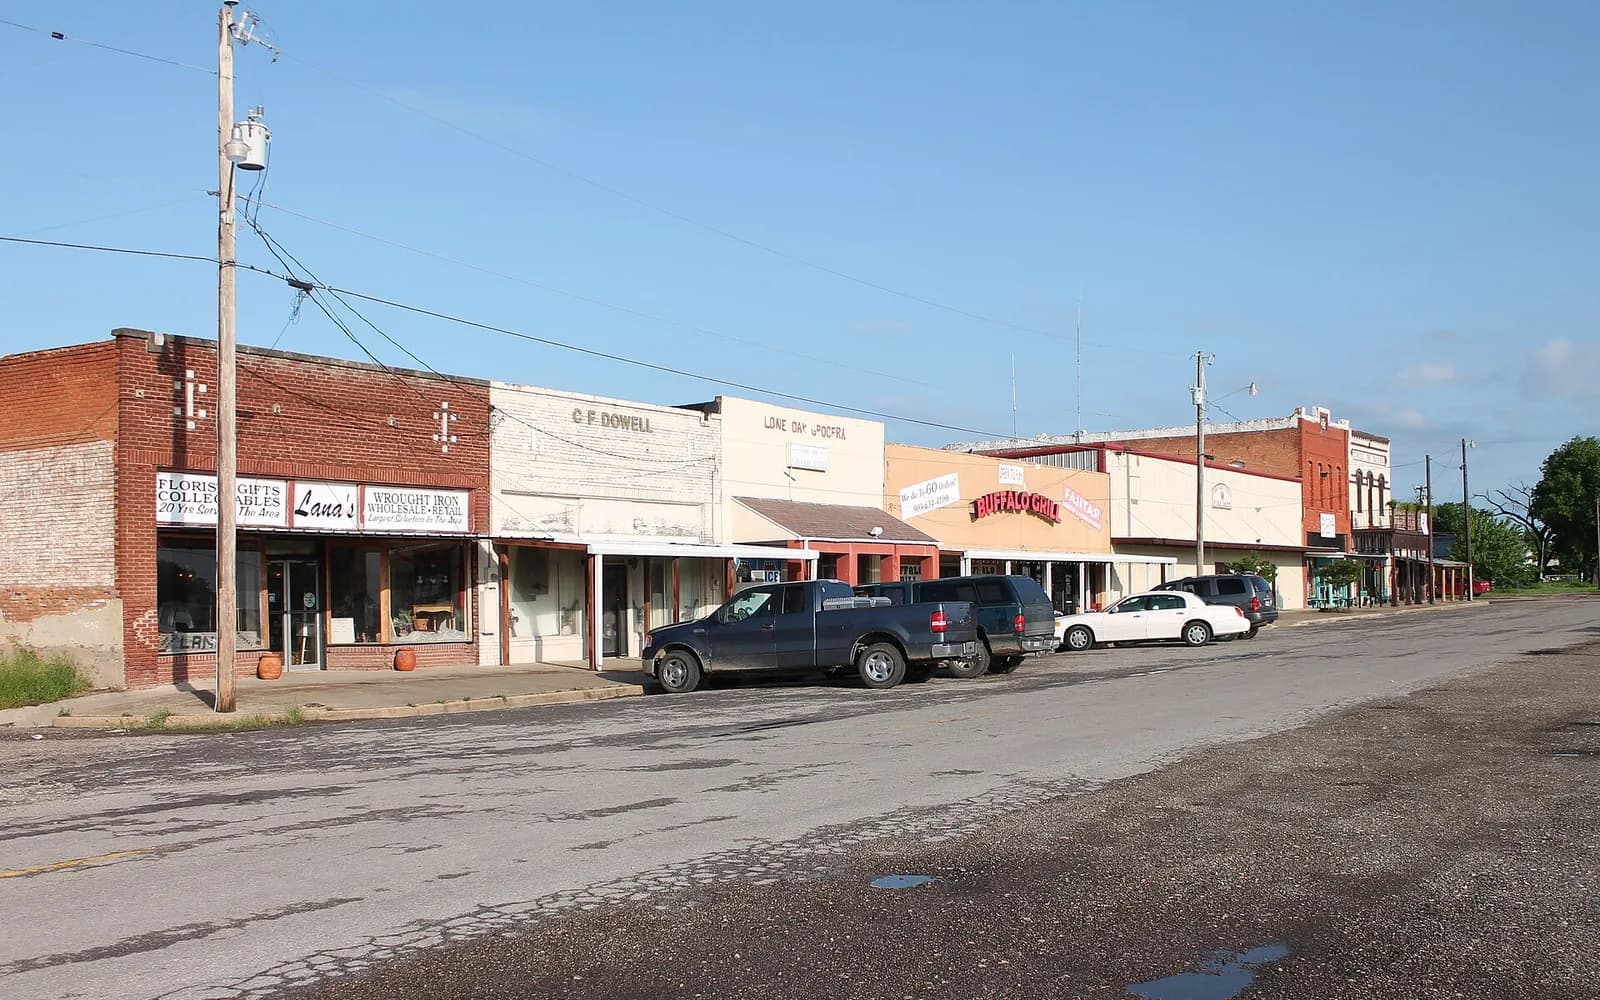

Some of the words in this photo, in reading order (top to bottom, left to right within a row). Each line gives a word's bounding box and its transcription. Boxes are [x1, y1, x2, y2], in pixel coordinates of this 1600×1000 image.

[601, 411, 654, 433] DOWELL
[764, 415, 787, 432] LONE
[158, 479, 217, 493] FLORIS
[237, 483, 281, 496] GIFTS
[158, 491, 281, 508] COLLEABLES
[294, 489, 356, 519] Lana's
[373, 491, 431, 506] WROUGHT
[434, 495, 459, 507] IRON
[976, 490, 1030, 519] BUFFALO
[1031, 492, 1061, 524] GRILL
[158, 502, 175, 513] 20
[177, 502, 195, 515] Yrs
[196, 503, 217, 515] Serv
[239, 506, 256, 517] The
[257, 507, 280, 518] Area
[764, 571, 779, 582] ICE
